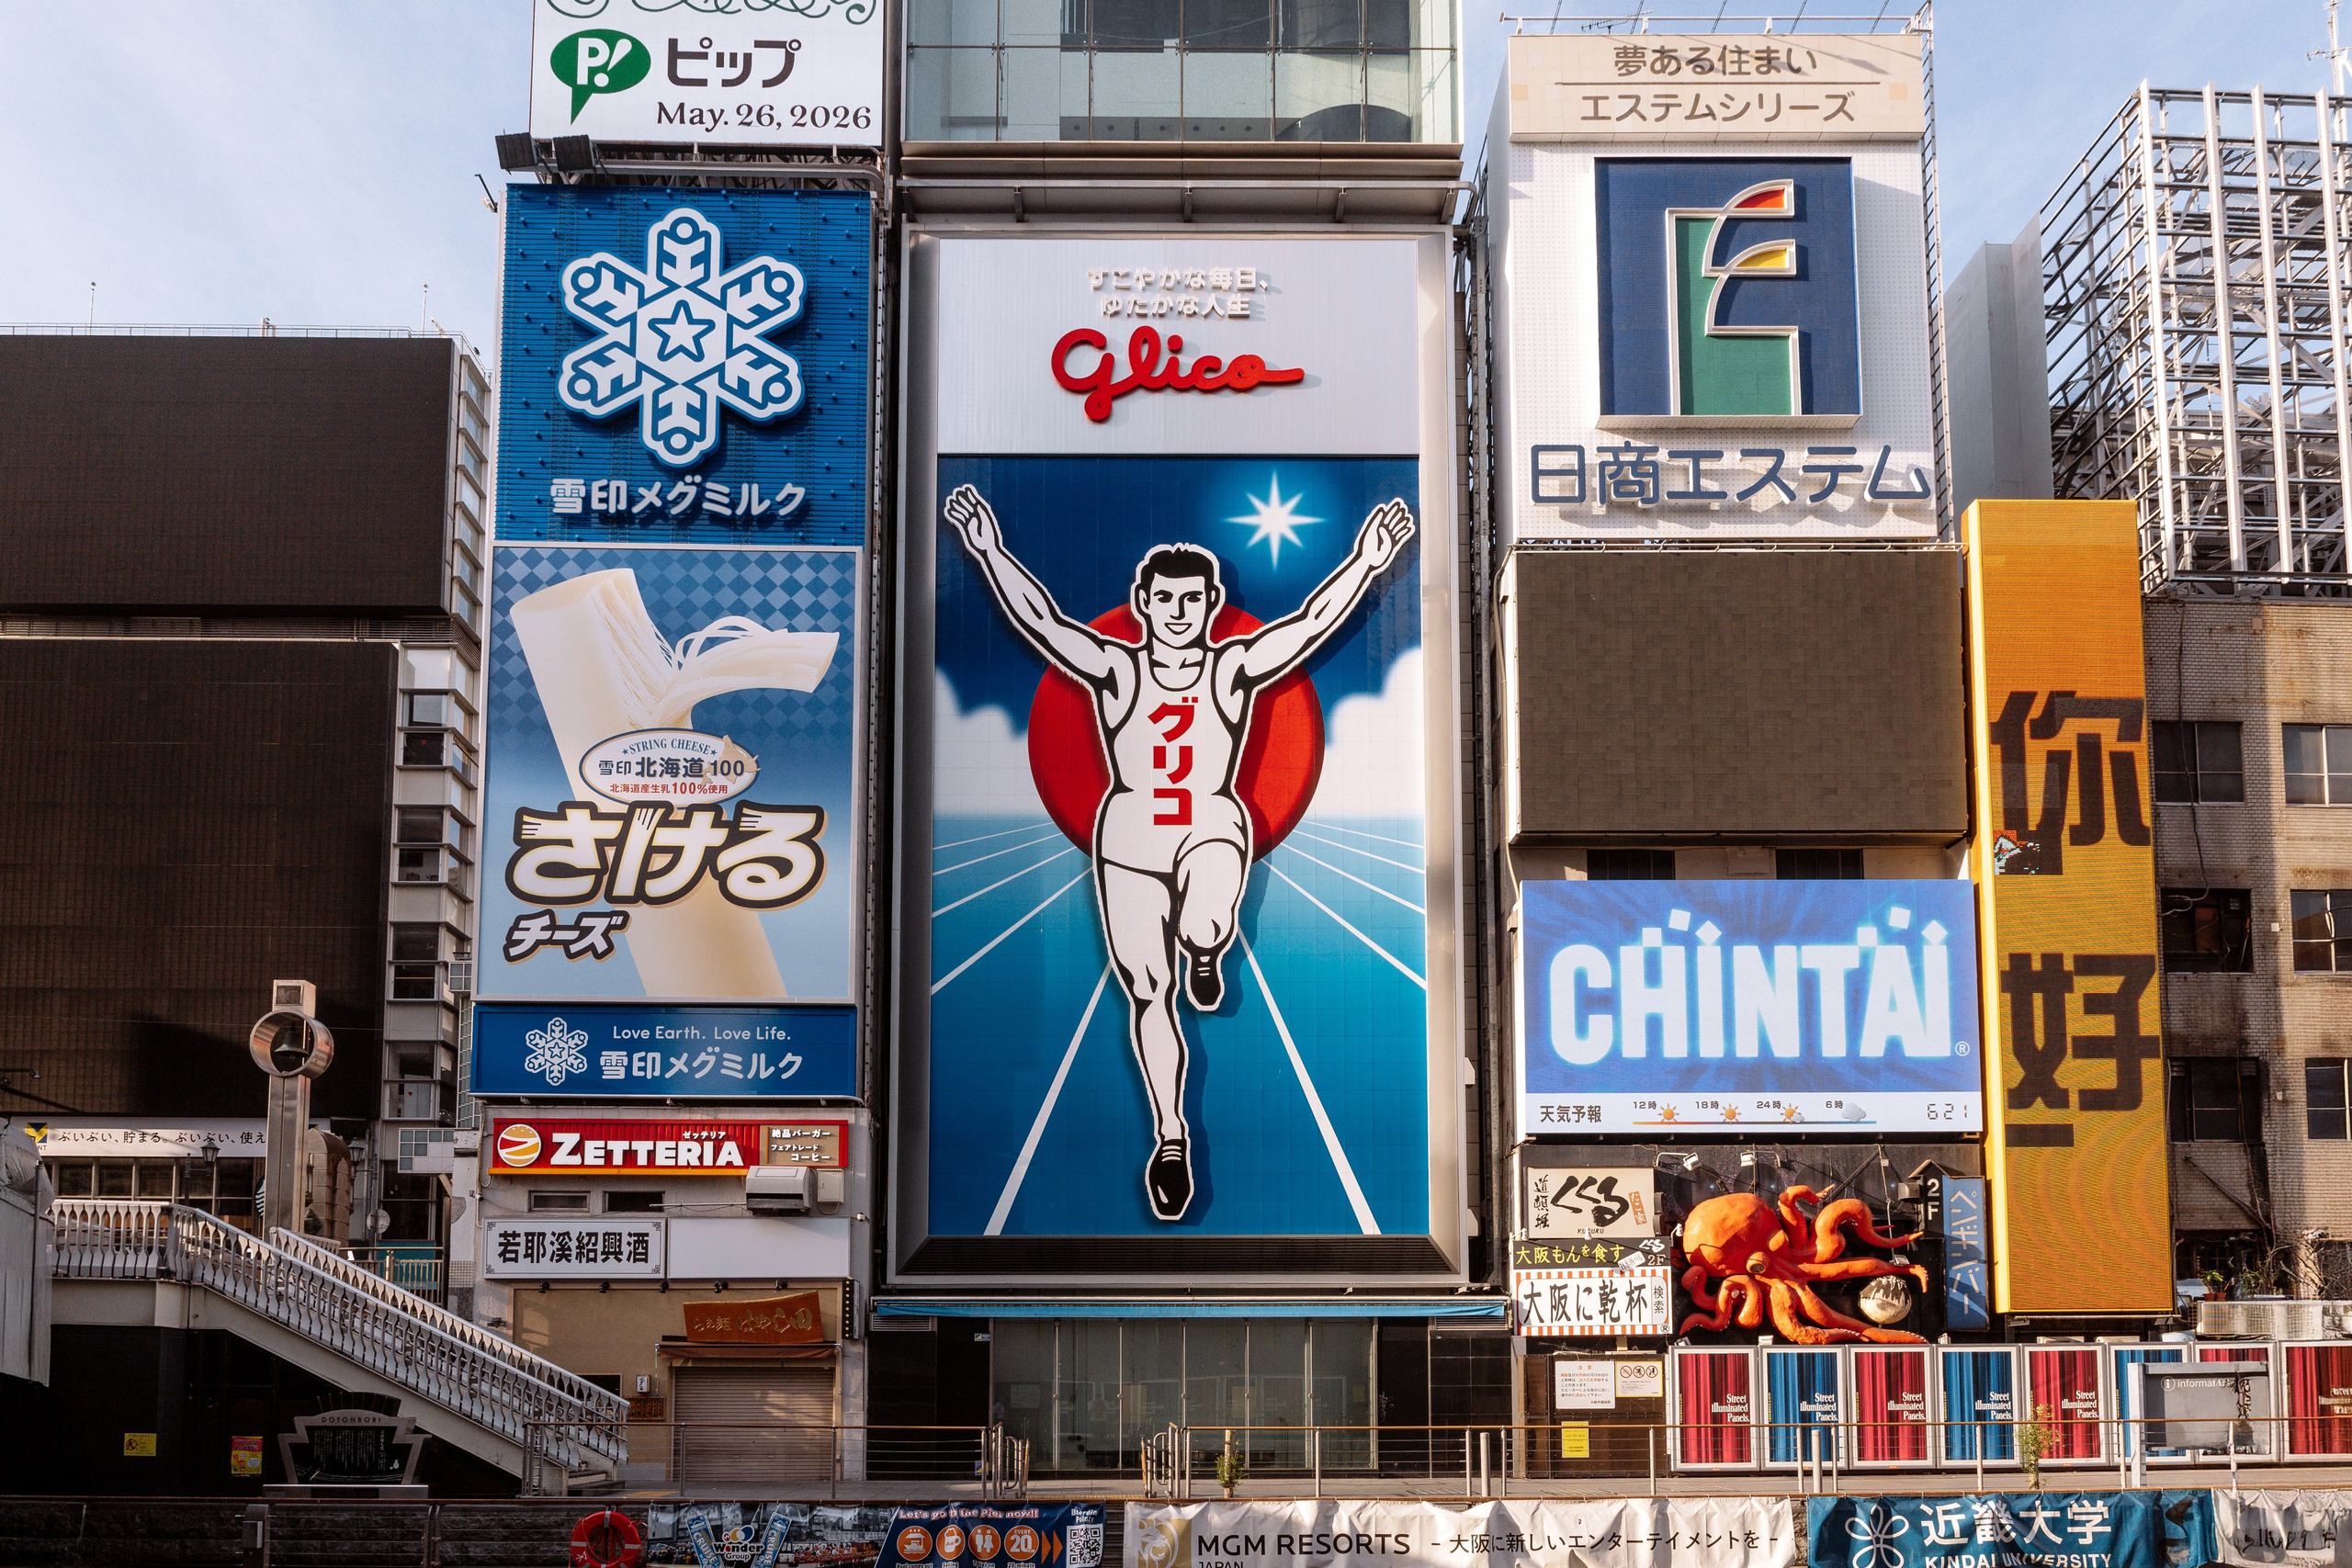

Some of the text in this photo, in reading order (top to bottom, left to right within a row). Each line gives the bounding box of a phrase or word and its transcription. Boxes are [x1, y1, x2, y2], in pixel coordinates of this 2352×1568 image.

[667, 38, 802, 88] ピップ
[1613, 44, 1817, 77] 夢ある住まい
[1580, 89, 1856, 123] エステムシリーズ
[656, 102, 871, 132] May. 26, 2026
[1087, 266, 1269, 291] すこやかな毎日、
[1102, 293, 1250, 318] ゆたかな人生
[1531, 440, 1931, 507] 日商エステム
[550, 474, 807, 517] 雪印メグミルク
[629, 736, 713, 757] STRING CHEESE
[1148, 695, 1198, 827] グリコ
[609, 781, 729, 796] 北海道産生乳100%使用
[506, 801, 824, 908] さける
[503, 909, 627, 963] チーズ
[613, 1025, 791, 1042] Love Earth. Love Life.
[599, 1046, 804, 1080] 雪印メグミルク
[1540, 1104, 1602, 1124] 天気予報
[1633, 1100, 1657, 1111] 12時
[1695, 1100, 1720, 1111] 18時
[1756, 1100, 1781, 1111] 24時
[1825, 1100, 1844, 1111] 6時
[683, 1130, 727, 1140] ゼッテリア
[771, 1128, 831, 1139] 絶品バーガー
[550, 1133, 744, 1167] ZETTERIA
[770, 1143, 820, 1153] フェアトレード
[790, 1152, 831, 1163] コーヒー
[1533, 1174, 1550, 1230] 道頓堀
[1550, 1175, 1630, 1227] くくる
[497, 1230, 650, 1264] 若耶溪紹興酒
[1516, 1243, 1624, 1266] 大阪もんを食す
[1950, 1190, 1981, 1314] ペンギンバー
[1647, 1254, 1667, 1266] 2F
[1523, 1279, 1648, 1325] 大阪に乾杯
[1653, 1285, 1665, 1314] 検索
[1726, 1393, 1747, 1404] Street
[1814, 1393, 1835, 1403] Street
[1902, 1392, 1922, 1402] Street
[1989, 1392, 2009, 1401] Street
[2075, 1390, 2096, 1400] Street
[1727, 1413, 1750, 1422] Panels.
[1815, 1412, 1838, 1421] Panels.
[1903, 1411, 1927, 1420] Panels.
[1990, 1410, 2013, 1420] Panels.
[2076, 1409, 2099, 1418] Panels.
[899, 1508, 929, 1519] Let's
[931, 1509, 947, 1521] go
[959, 1507, 978, 1518] the
[979, 1507, 1005, 1518] Pier
[1006, 1507, 1039, 1519] now!!
[1921, 1499, 2112, 1546] 近畿大学
[714, 1543, 764, 1554] Wonder
[1011, 1535, 1032, 1553] 20
[1197, 1533, 1411, 1556] MGM RESORTS
[726, 1553, 751, 1562] Group
